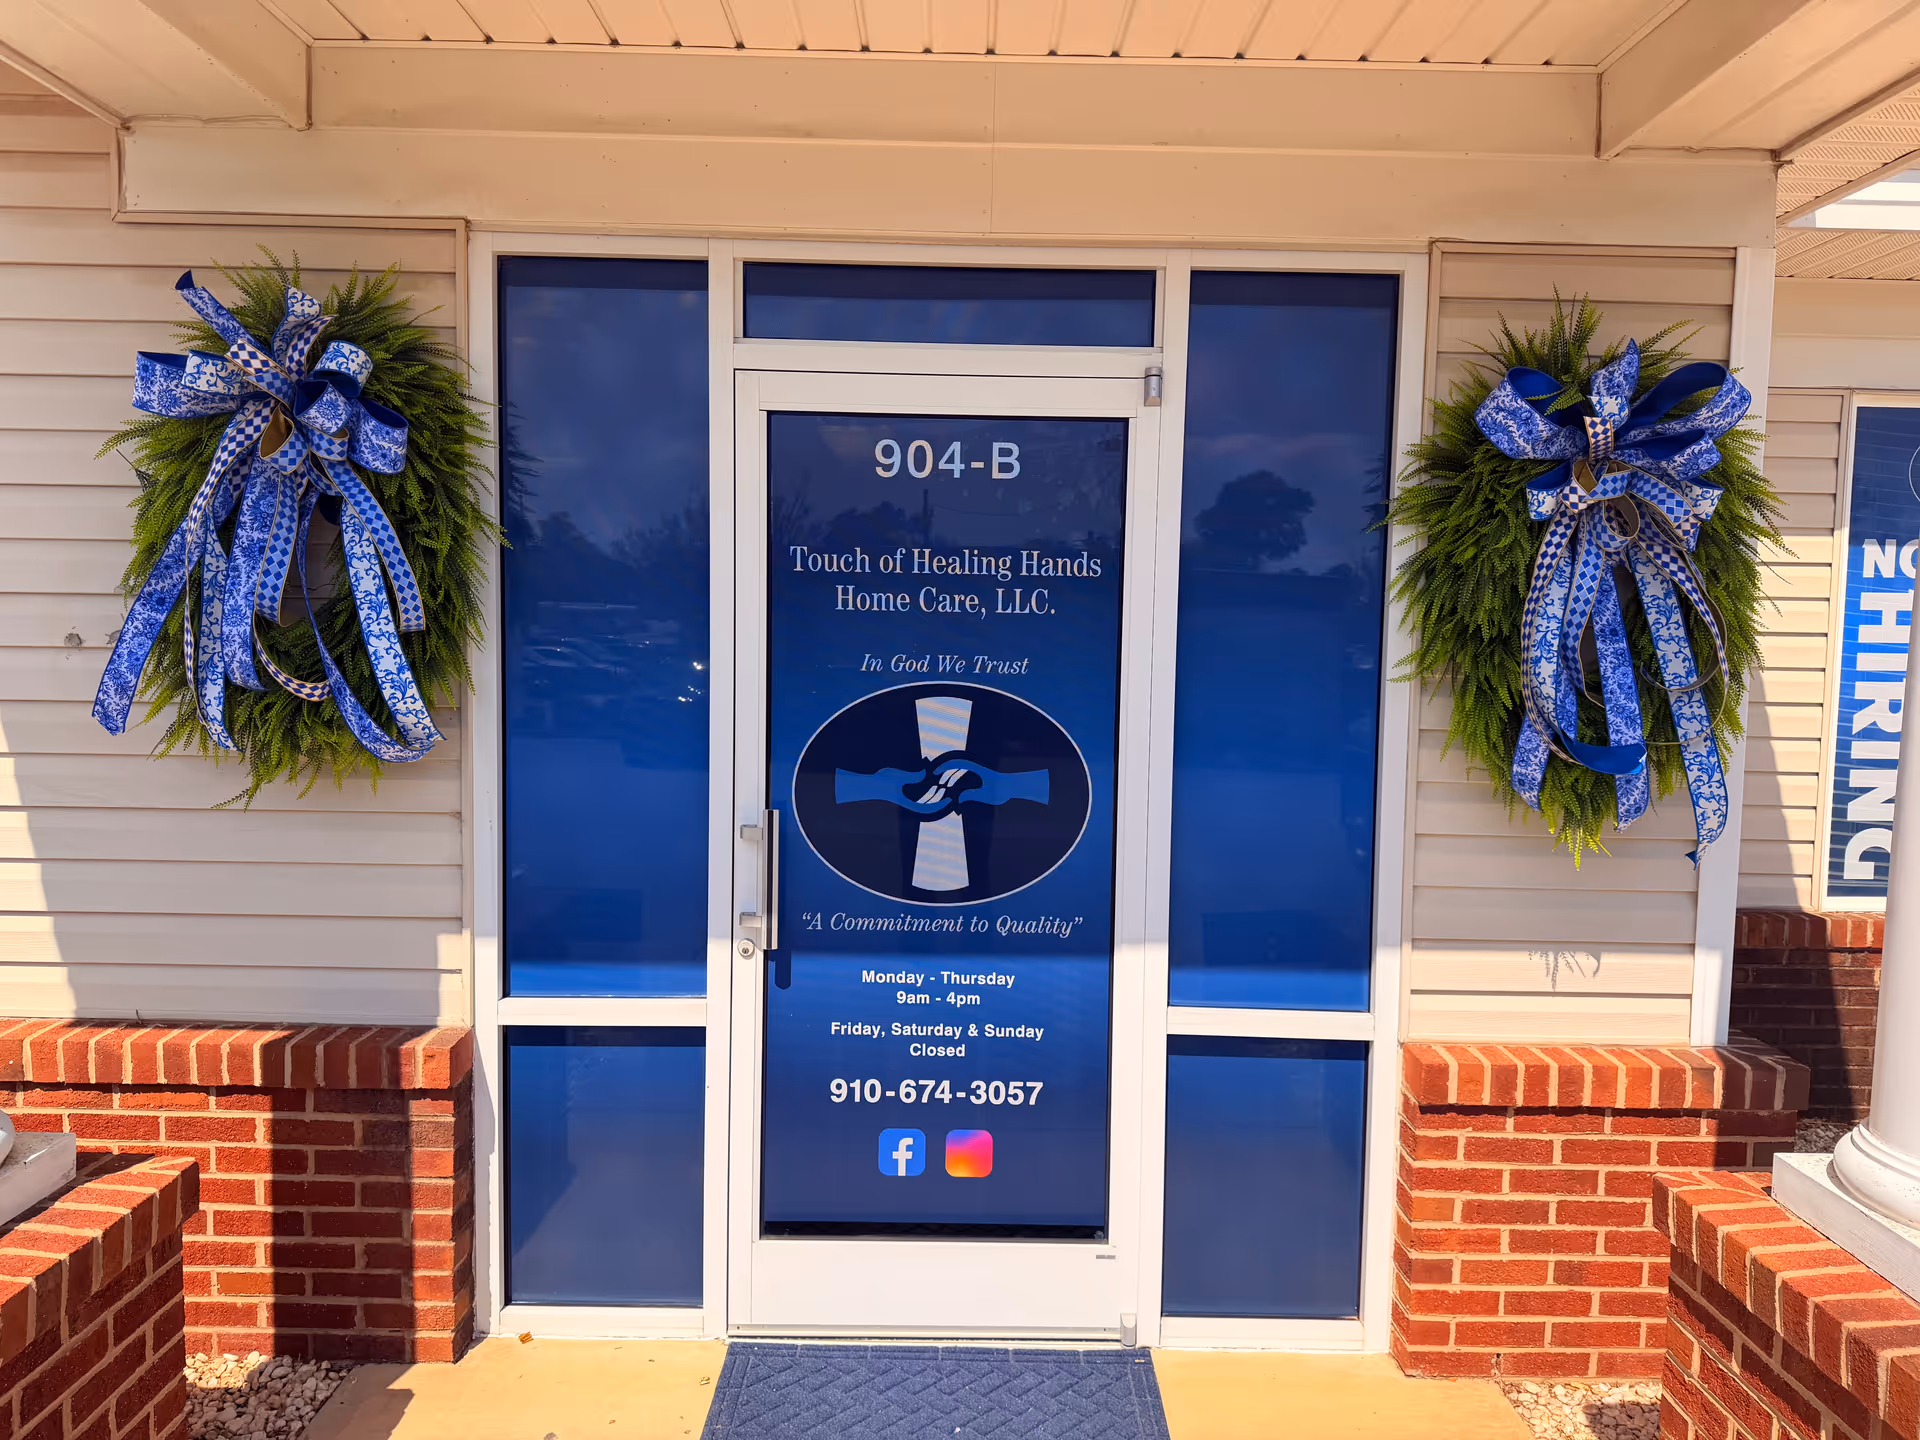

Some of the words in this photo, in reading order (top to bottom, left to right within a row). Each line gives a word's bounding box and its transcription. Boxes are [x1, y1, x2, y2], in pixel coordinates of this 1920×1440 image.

[874, 438, 1021, 480] 904-B
[789, 545, 872, 573] Touch
[879, 547, 906, 574] of
[911, 548, 1012, 582] Healing
[1019, 550, 1102, 578] Hands
[835, 585, 911, 612] Home
[918, 586, 986, 620] Care,
[995, 588, 1056, 615] LLC.
[859, 653, 884, 672] In
[890, 653, 931, 673] God
[937, 654, 966, 674] We
[973, 655, 1030, 675] Trust
[1843, 588, 1915, 880] HIRING
[802, 912, 823, 930] “A
[830, 912, 964, 932] Commitment
[970, 915, 989, 933] to
[996, 915, 1083, 939] Quality”
[861, 969, 925, 987] Monday
[940, 970, 1016, 989] Thursday
[896, 990, 930, 1005] 9am
[946, 991, 981, 1008] 4pm
[831, 1021, 886, 1039] Friday,
[891, 1022, 963, 1040] Saturday
[967, 1023, 979, 1037] &
[984, 1023, 1045, 1042] Sunday
[909, 1042, 966, 1057] Closed
[829, 1078, 1044, 1106] 910-674-3057
[892, 1137, 914, 1177] f
